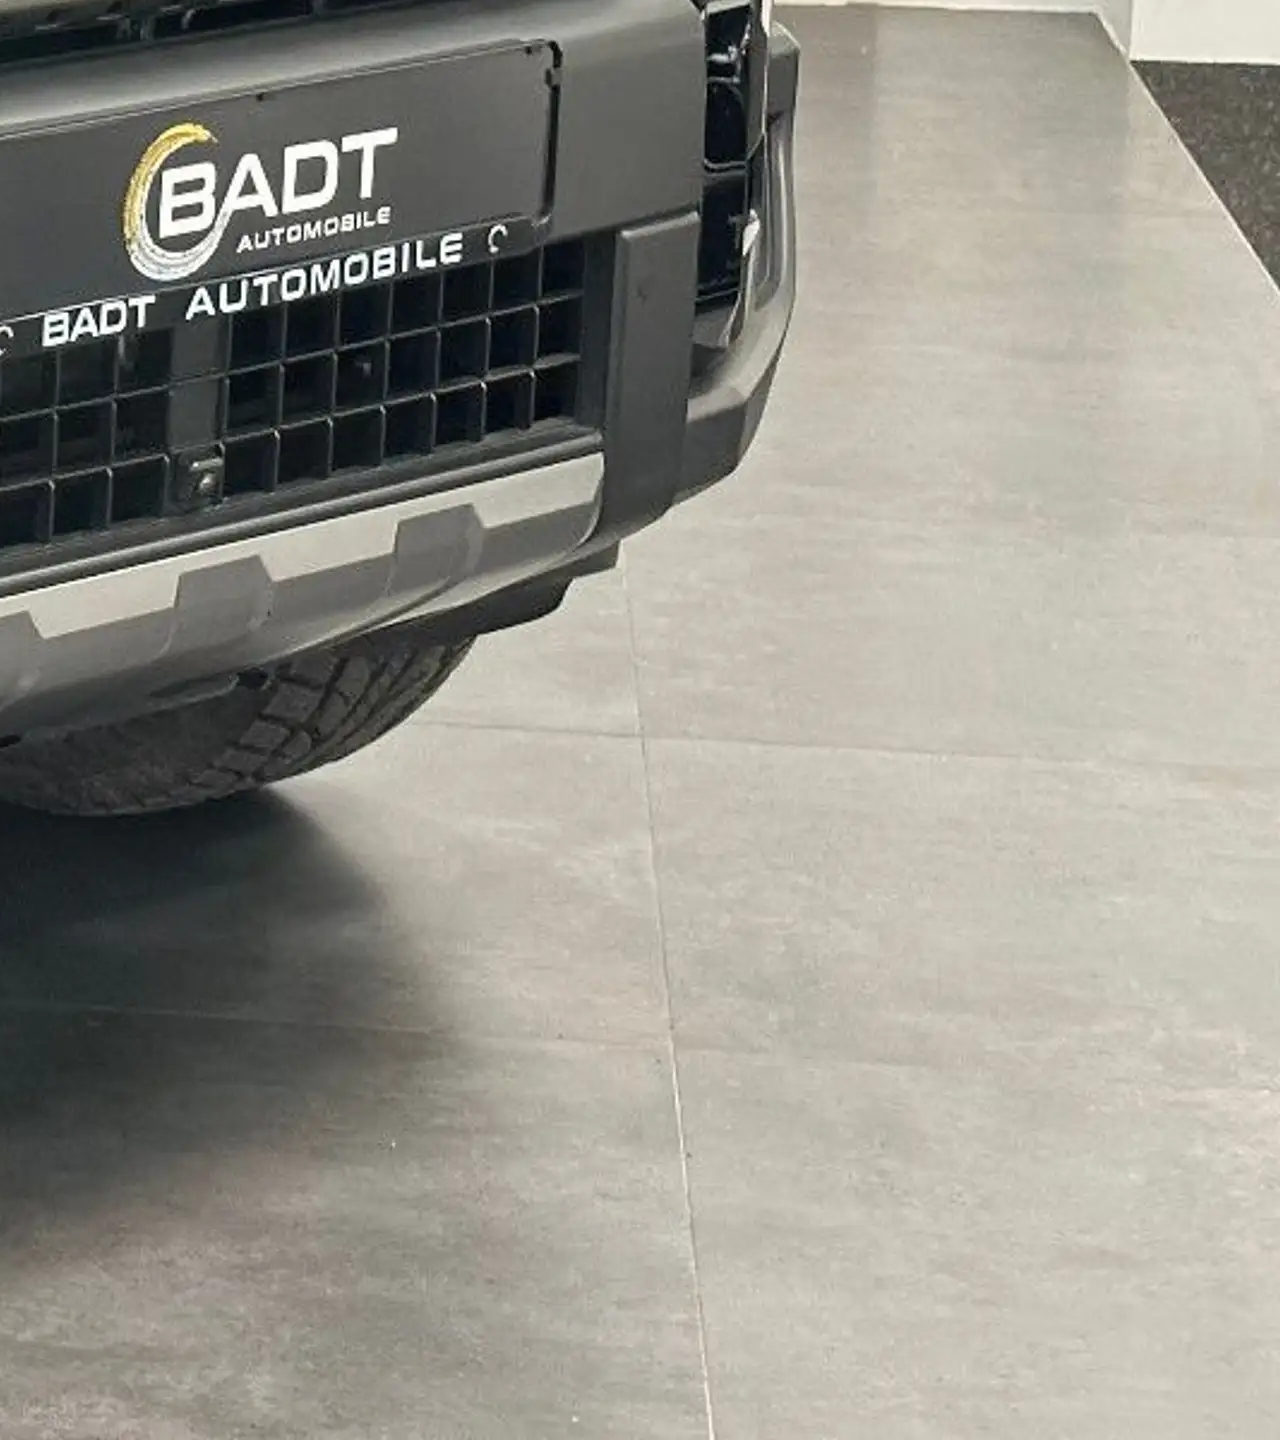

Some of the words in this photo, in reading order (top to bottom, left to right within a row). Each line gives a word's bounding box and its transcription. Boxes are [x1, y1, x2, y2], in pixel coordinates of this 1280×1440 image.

[157, 127, 399, 239] BADT
[236, 206, 392, 254] AUTOMOBILE
[41, 294, 156, 348] BADT
[185, 232, 464, 322] AUTOMOBILE
